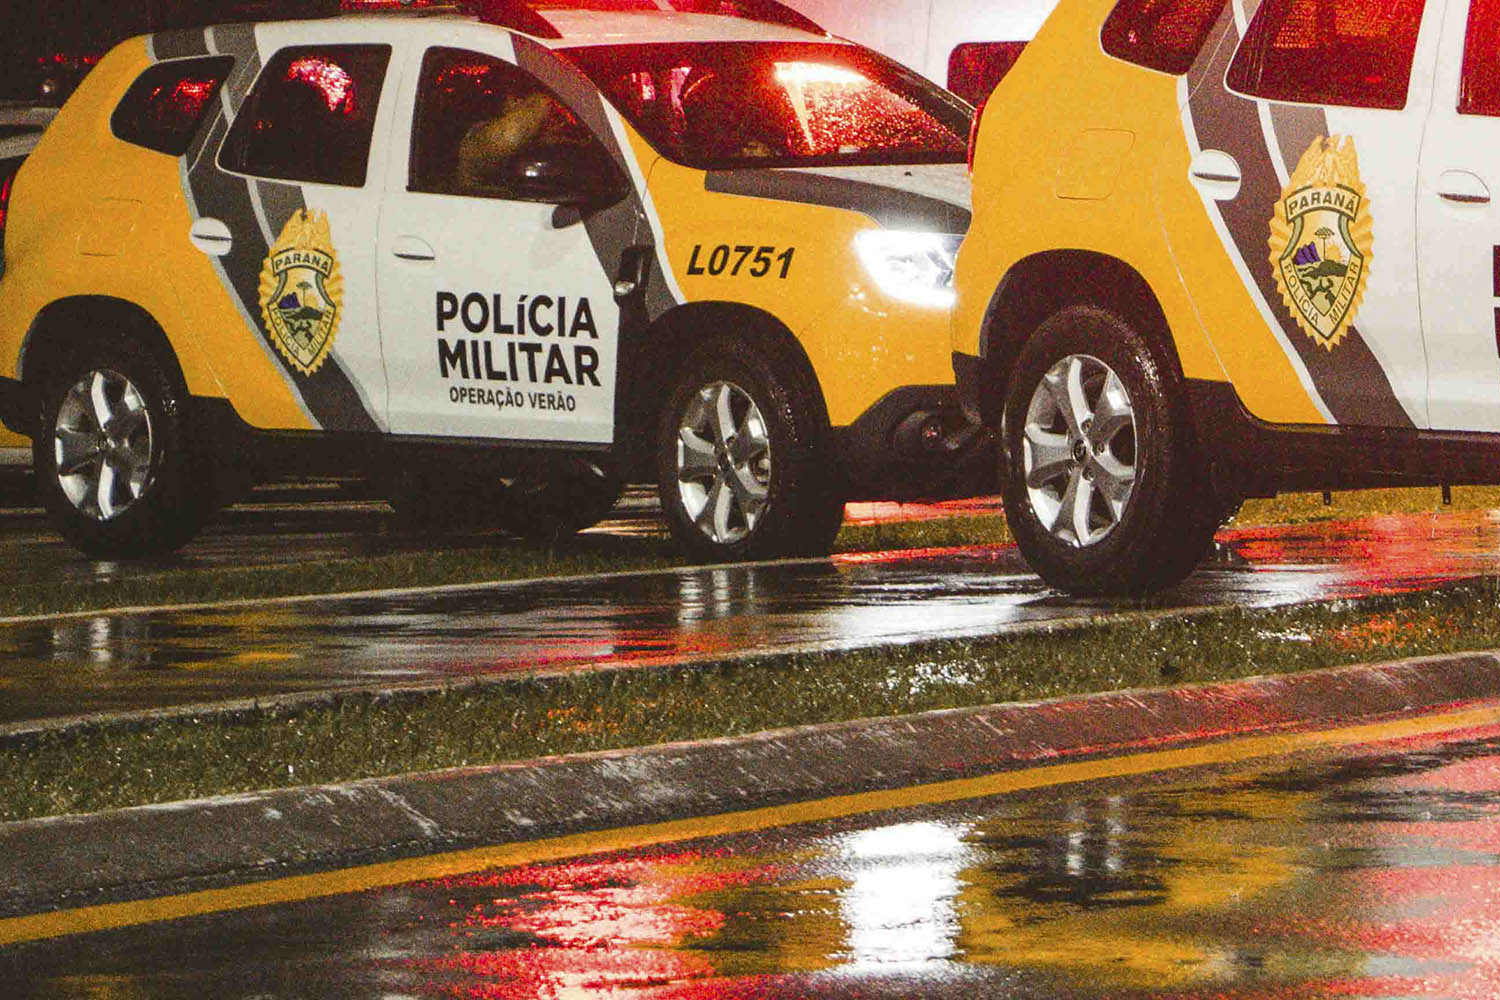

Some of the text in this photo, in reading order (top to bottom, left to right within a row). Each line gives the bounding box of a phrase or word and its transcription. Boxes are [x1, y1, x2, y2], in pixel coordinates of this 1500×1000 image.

[1288, 190, 1355, 216] PARANÁ
[686, 244, 796, 279] L0751
[1328, 262, 1360, 325] MILITAR
[436, 291, 600, 339] POLÍCIA
[437, 338, 602, 387] MILITAR
[449, 386, 577, 412] OPERAÇÃO VERÃO
